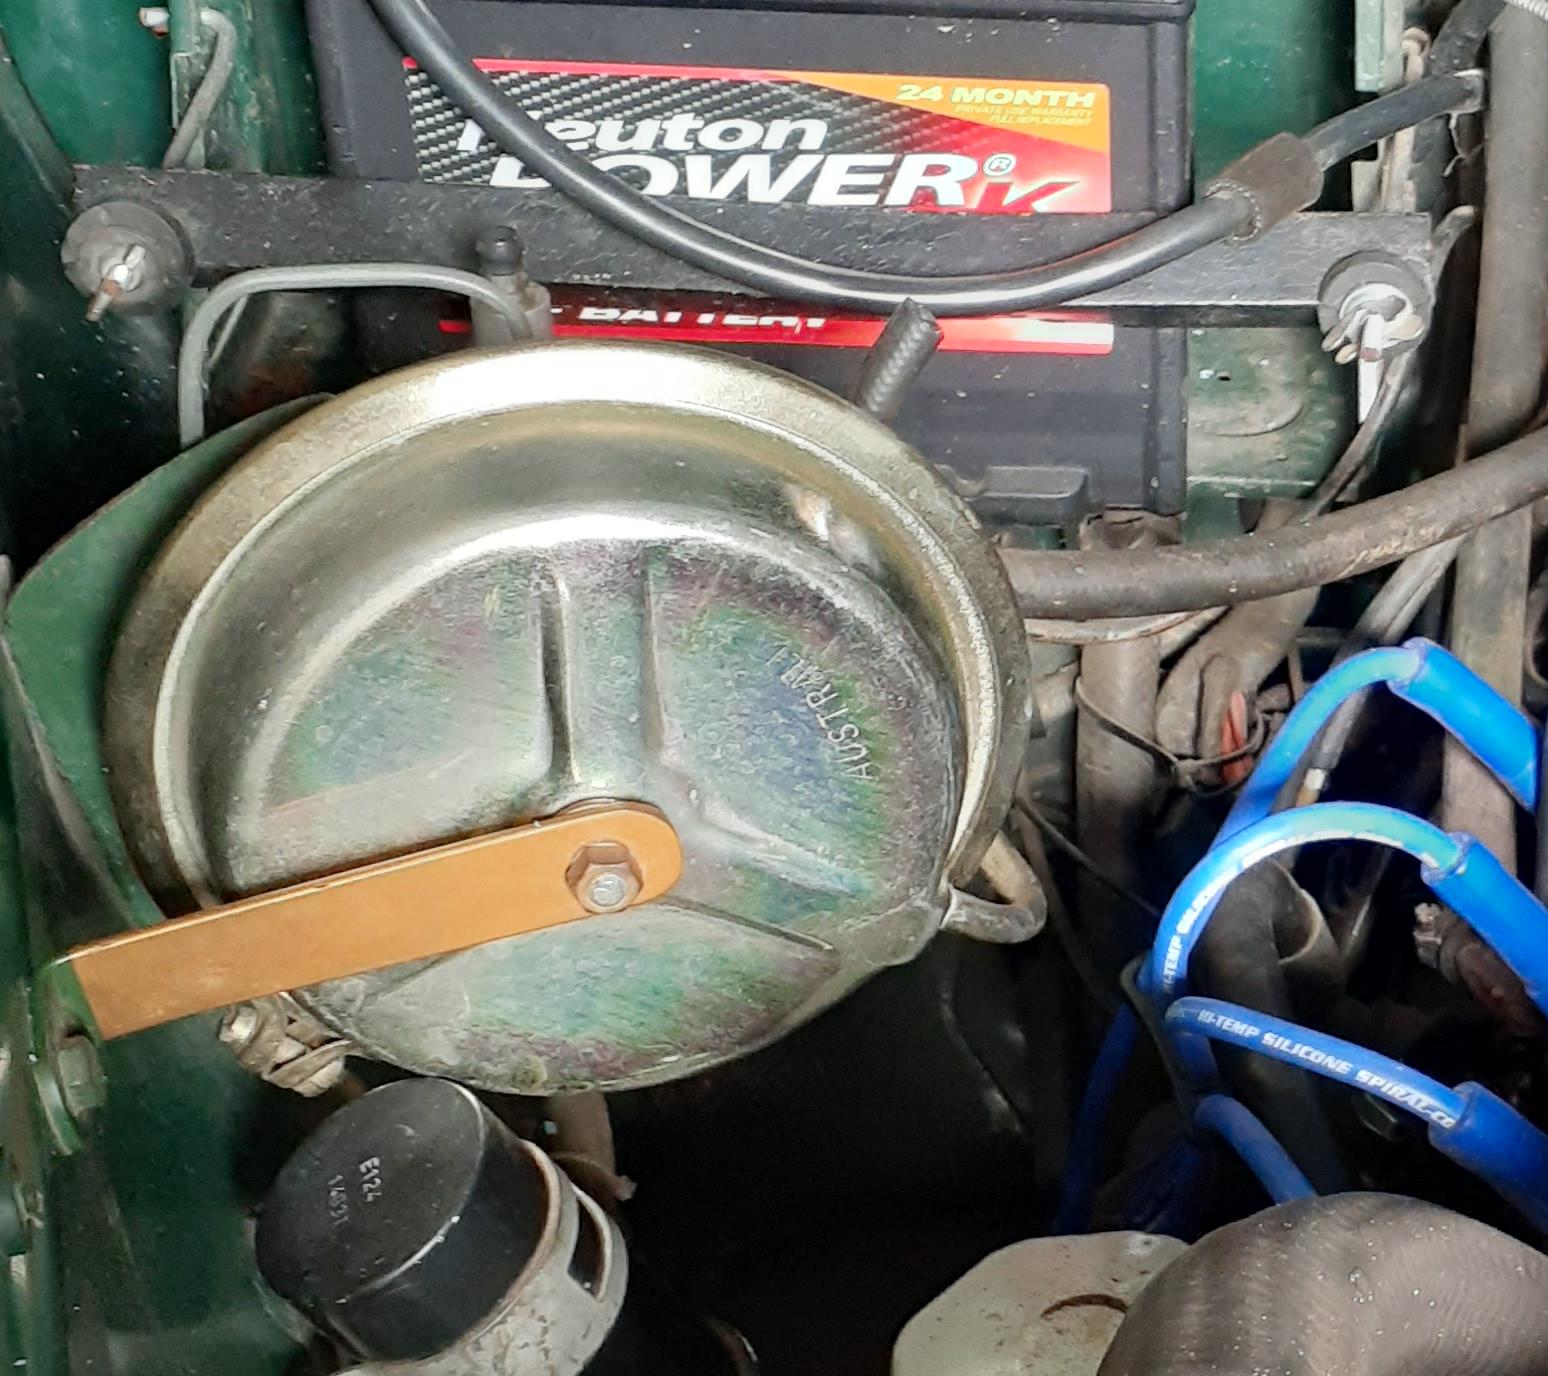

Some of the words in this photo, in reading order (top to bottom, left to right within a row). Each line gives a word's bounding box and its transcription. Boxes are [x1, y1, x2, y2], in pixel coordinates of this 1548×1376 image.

[896, 83, 944, 102] 24
[951, 85, 1097, 109] MONTH
[1260, 1031, 1354, 1076] SILICONE
